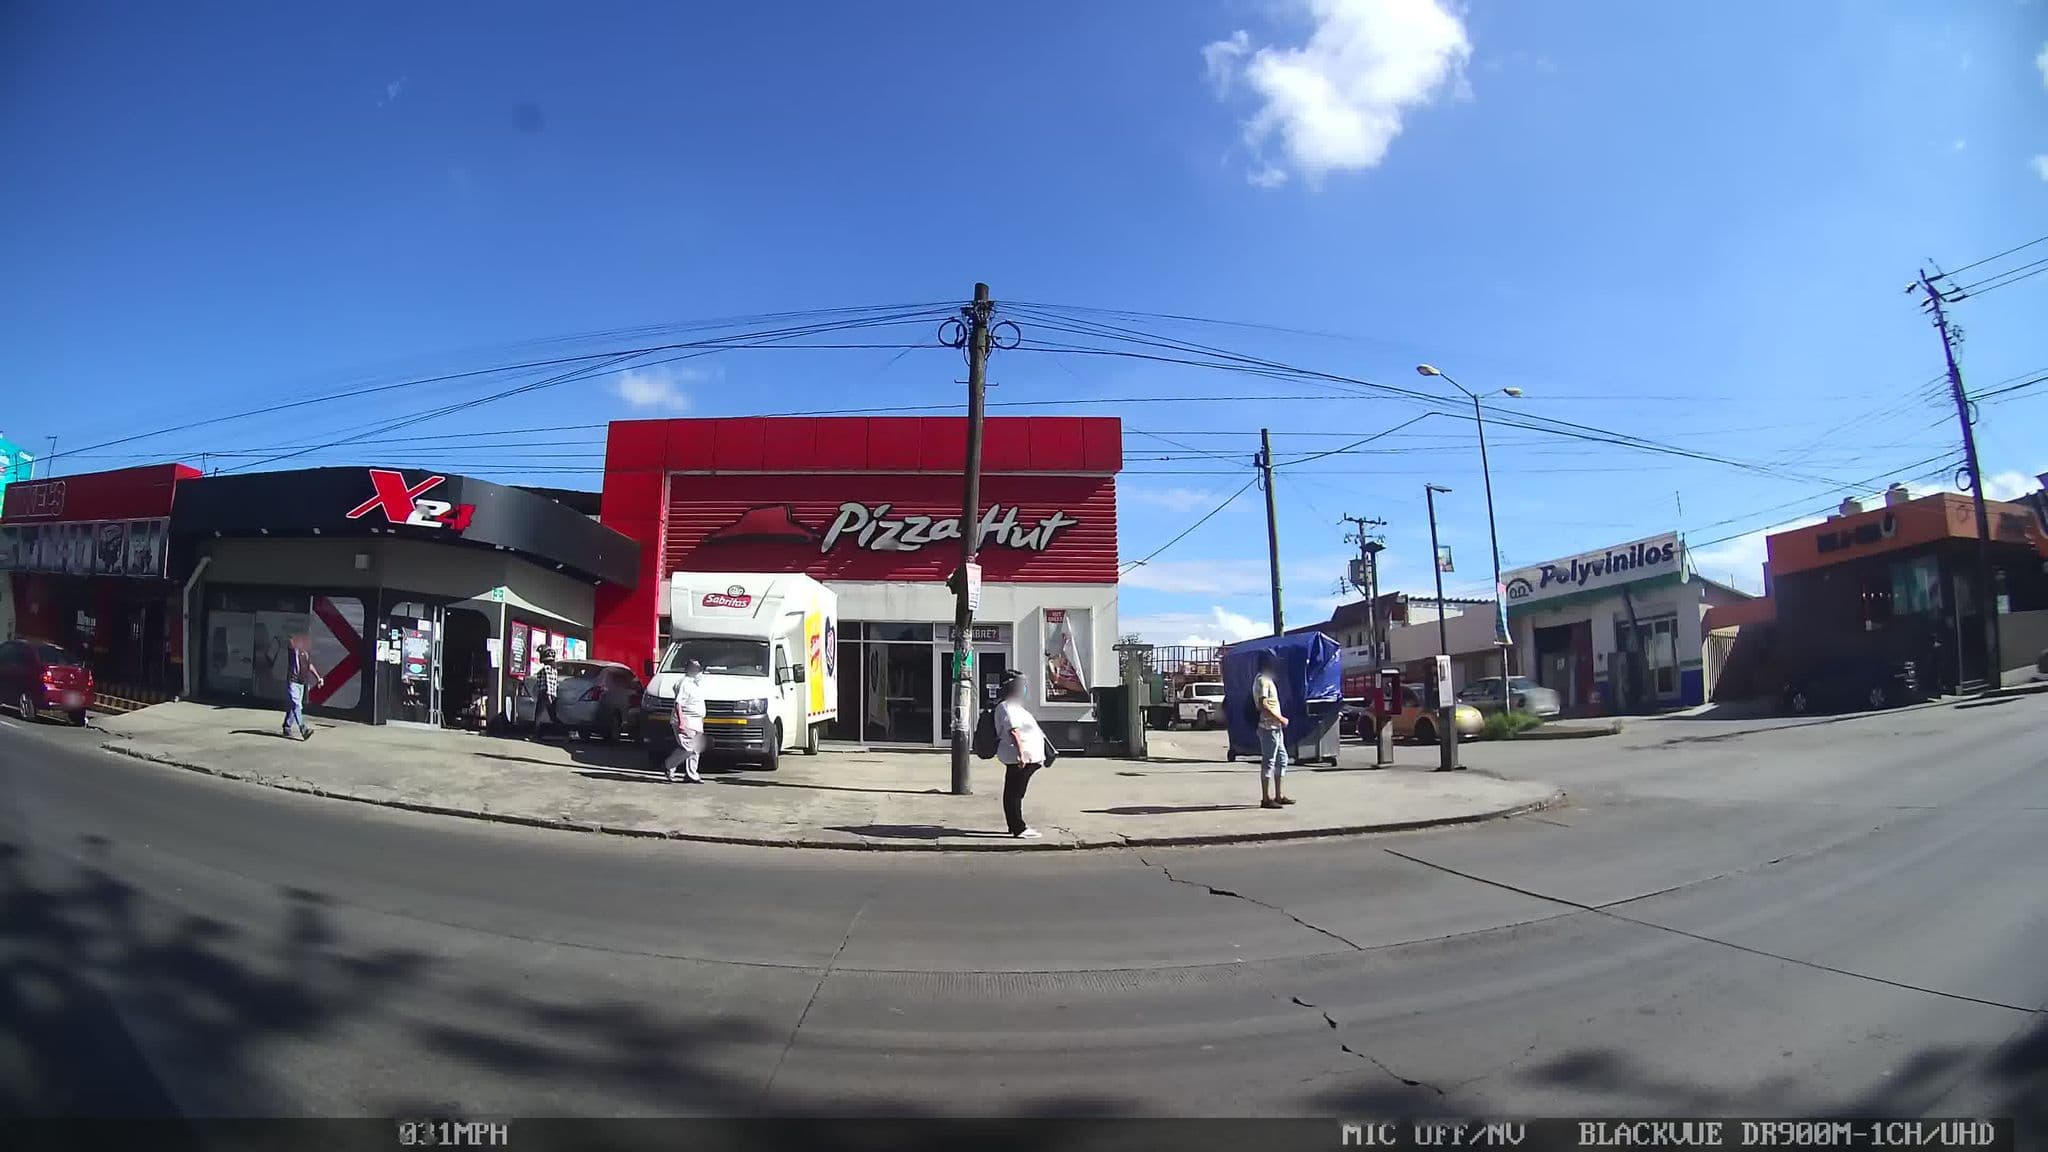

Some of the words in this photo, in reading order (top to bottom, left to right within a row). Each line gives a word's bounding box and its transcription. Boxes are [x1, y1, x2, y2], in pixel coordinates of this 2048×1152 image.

[345, 469, 477, 534] X24
[820, 502, 962, 553] Pizza
[975, 504, 1078, 551] Hut
[1536, 542, 1674, 588] Polyvinilos
[705, 595, 748, 608] Sabritas
